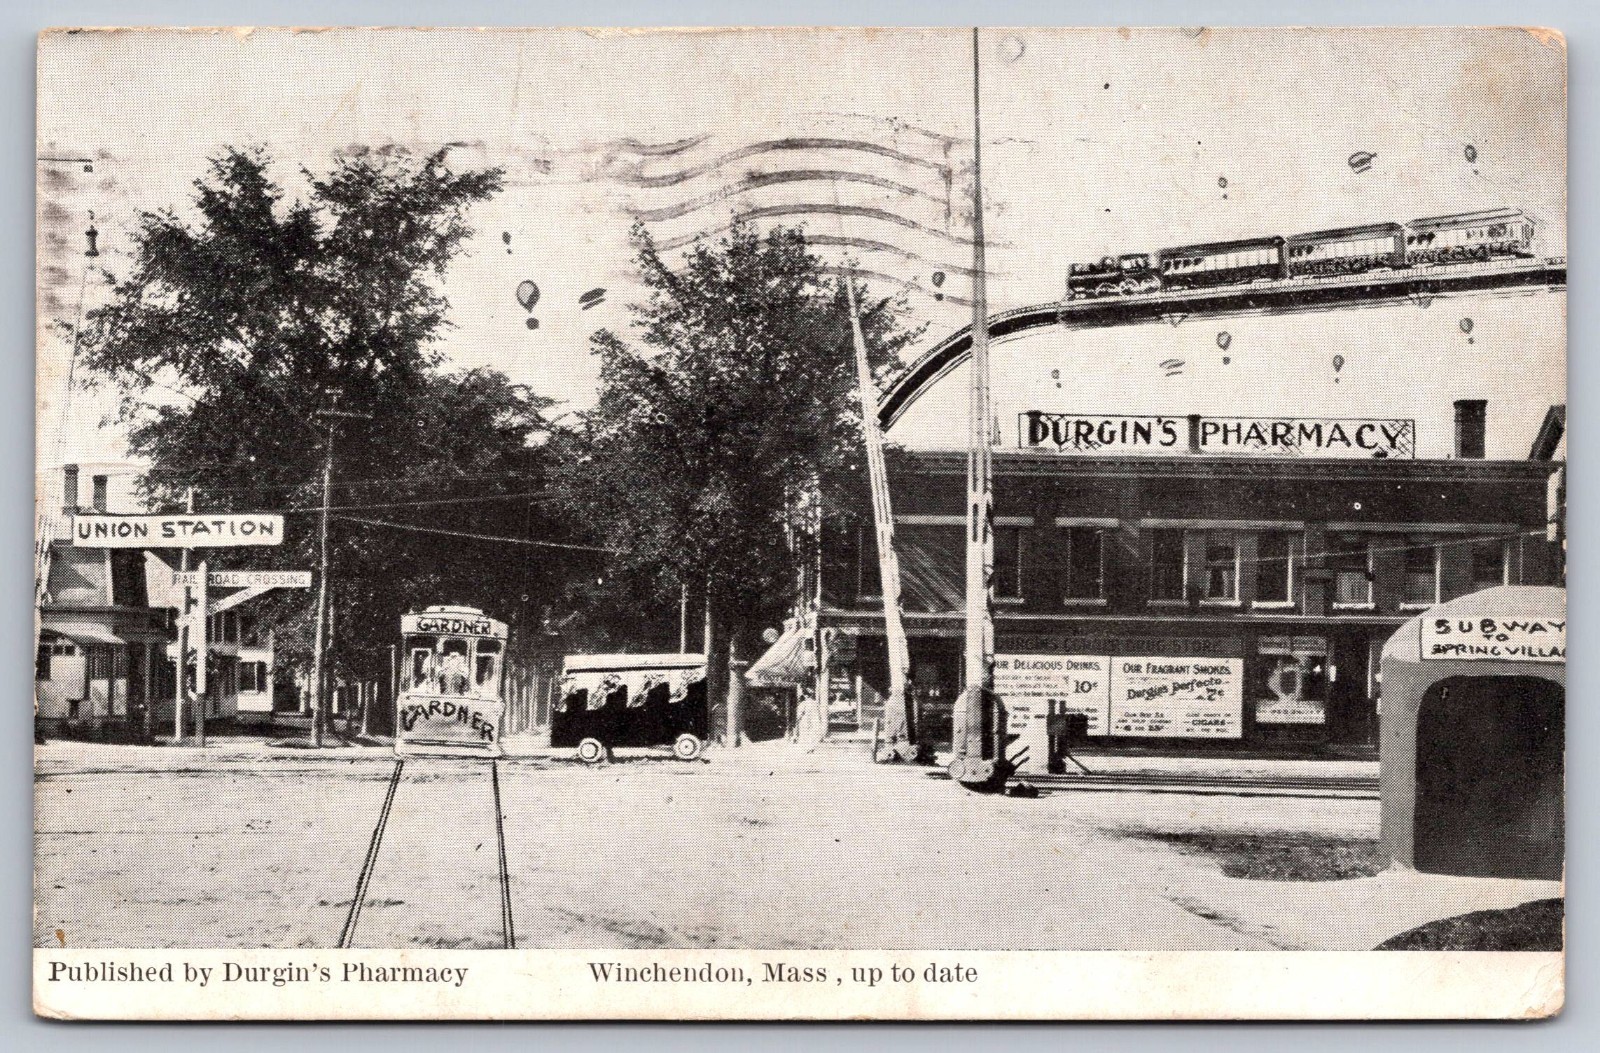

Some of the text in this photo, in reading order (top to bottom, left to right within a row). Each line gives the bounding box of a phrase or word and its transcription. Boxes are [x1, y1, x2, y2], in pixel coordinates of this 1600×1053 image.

[1029, 415, 1403, 451] DURGIN'S PHARMACY
[78, 520, 274, 539] UNION STATION
[417, 618, 491, 635] GARDNER
[1435, 618, 1566, 635] SUBWAY
[1482, 633, 1509, 642] TO
[1431, 643, 1501, 656] SPRING
[1122, 662, 1142, 674] OUR
[1146, 662, 1190, 675] FRAGRANT
